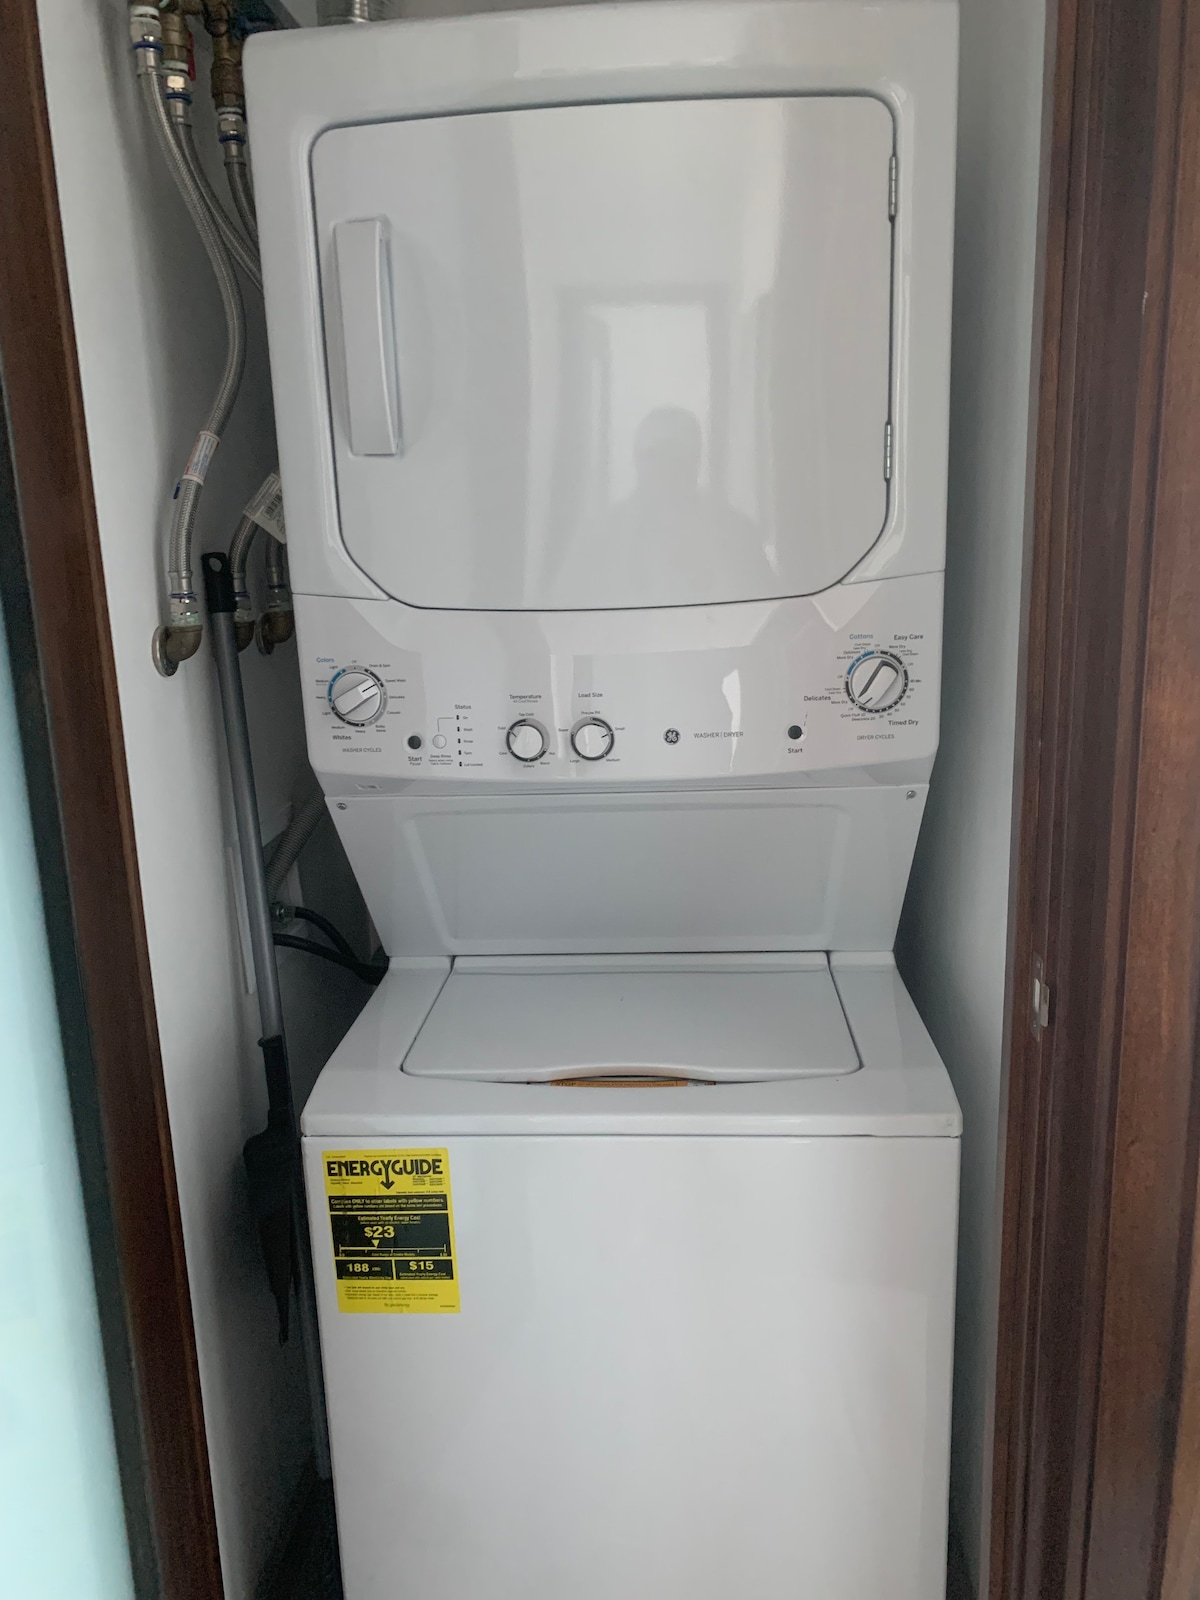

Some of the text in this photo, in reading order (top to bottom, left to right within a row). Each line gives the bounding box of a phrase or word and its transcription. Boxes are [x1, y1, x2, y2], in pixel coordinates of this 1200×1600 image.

[326, 1159, 443, 1178] ENERGYGUIDE
[364, 1225, 395, 1238] $23
[346, 1263, 369, 1272] 188
[409, 1261, 434, 1270] $15
